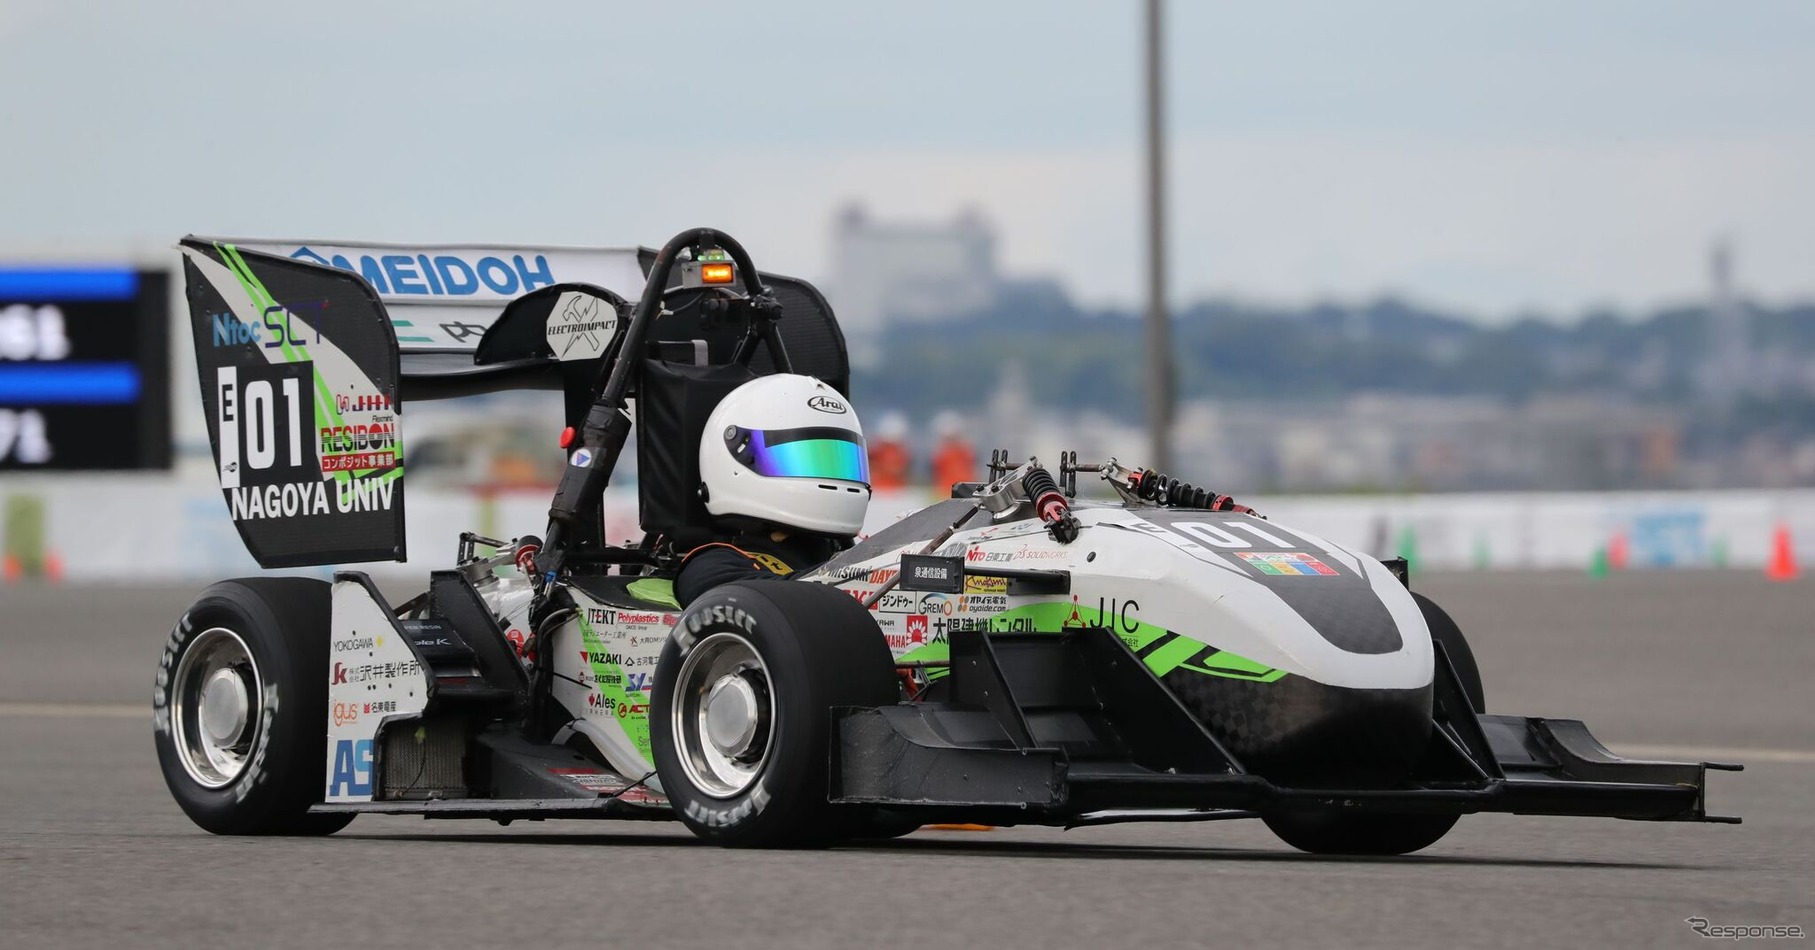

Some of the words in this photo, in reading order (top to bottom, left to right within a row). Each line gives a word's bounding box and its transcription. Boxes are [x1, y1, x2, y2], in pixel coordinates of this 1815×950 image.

[331, 253, 556, 295] MEIDOH
[547, 320, 617, 336] ELECTROIMPACT
[816, 397, 843, 411] Arai
[221, 383, 234, 422] E
[245, 377, 302, 470] 01
[320, 423, 395, 453] RESIBON
[231, 481, 330, 521] NAGOYA
[336, 477, 394, 513] UNIV
[882, 595, 913, 608] ジンドゥー
[918, 600, 953, 616] GREMO
[586, 608, 616, 626] JTEKT
[333, 638, 374, 652] YOKOGAWA
[589, 652, 622, 666] YAZAKI
[360, 660, 420, 682] 沢井製作所
[594, 694, 616, 710] Ales
[333, 699, 359, 727] igus
